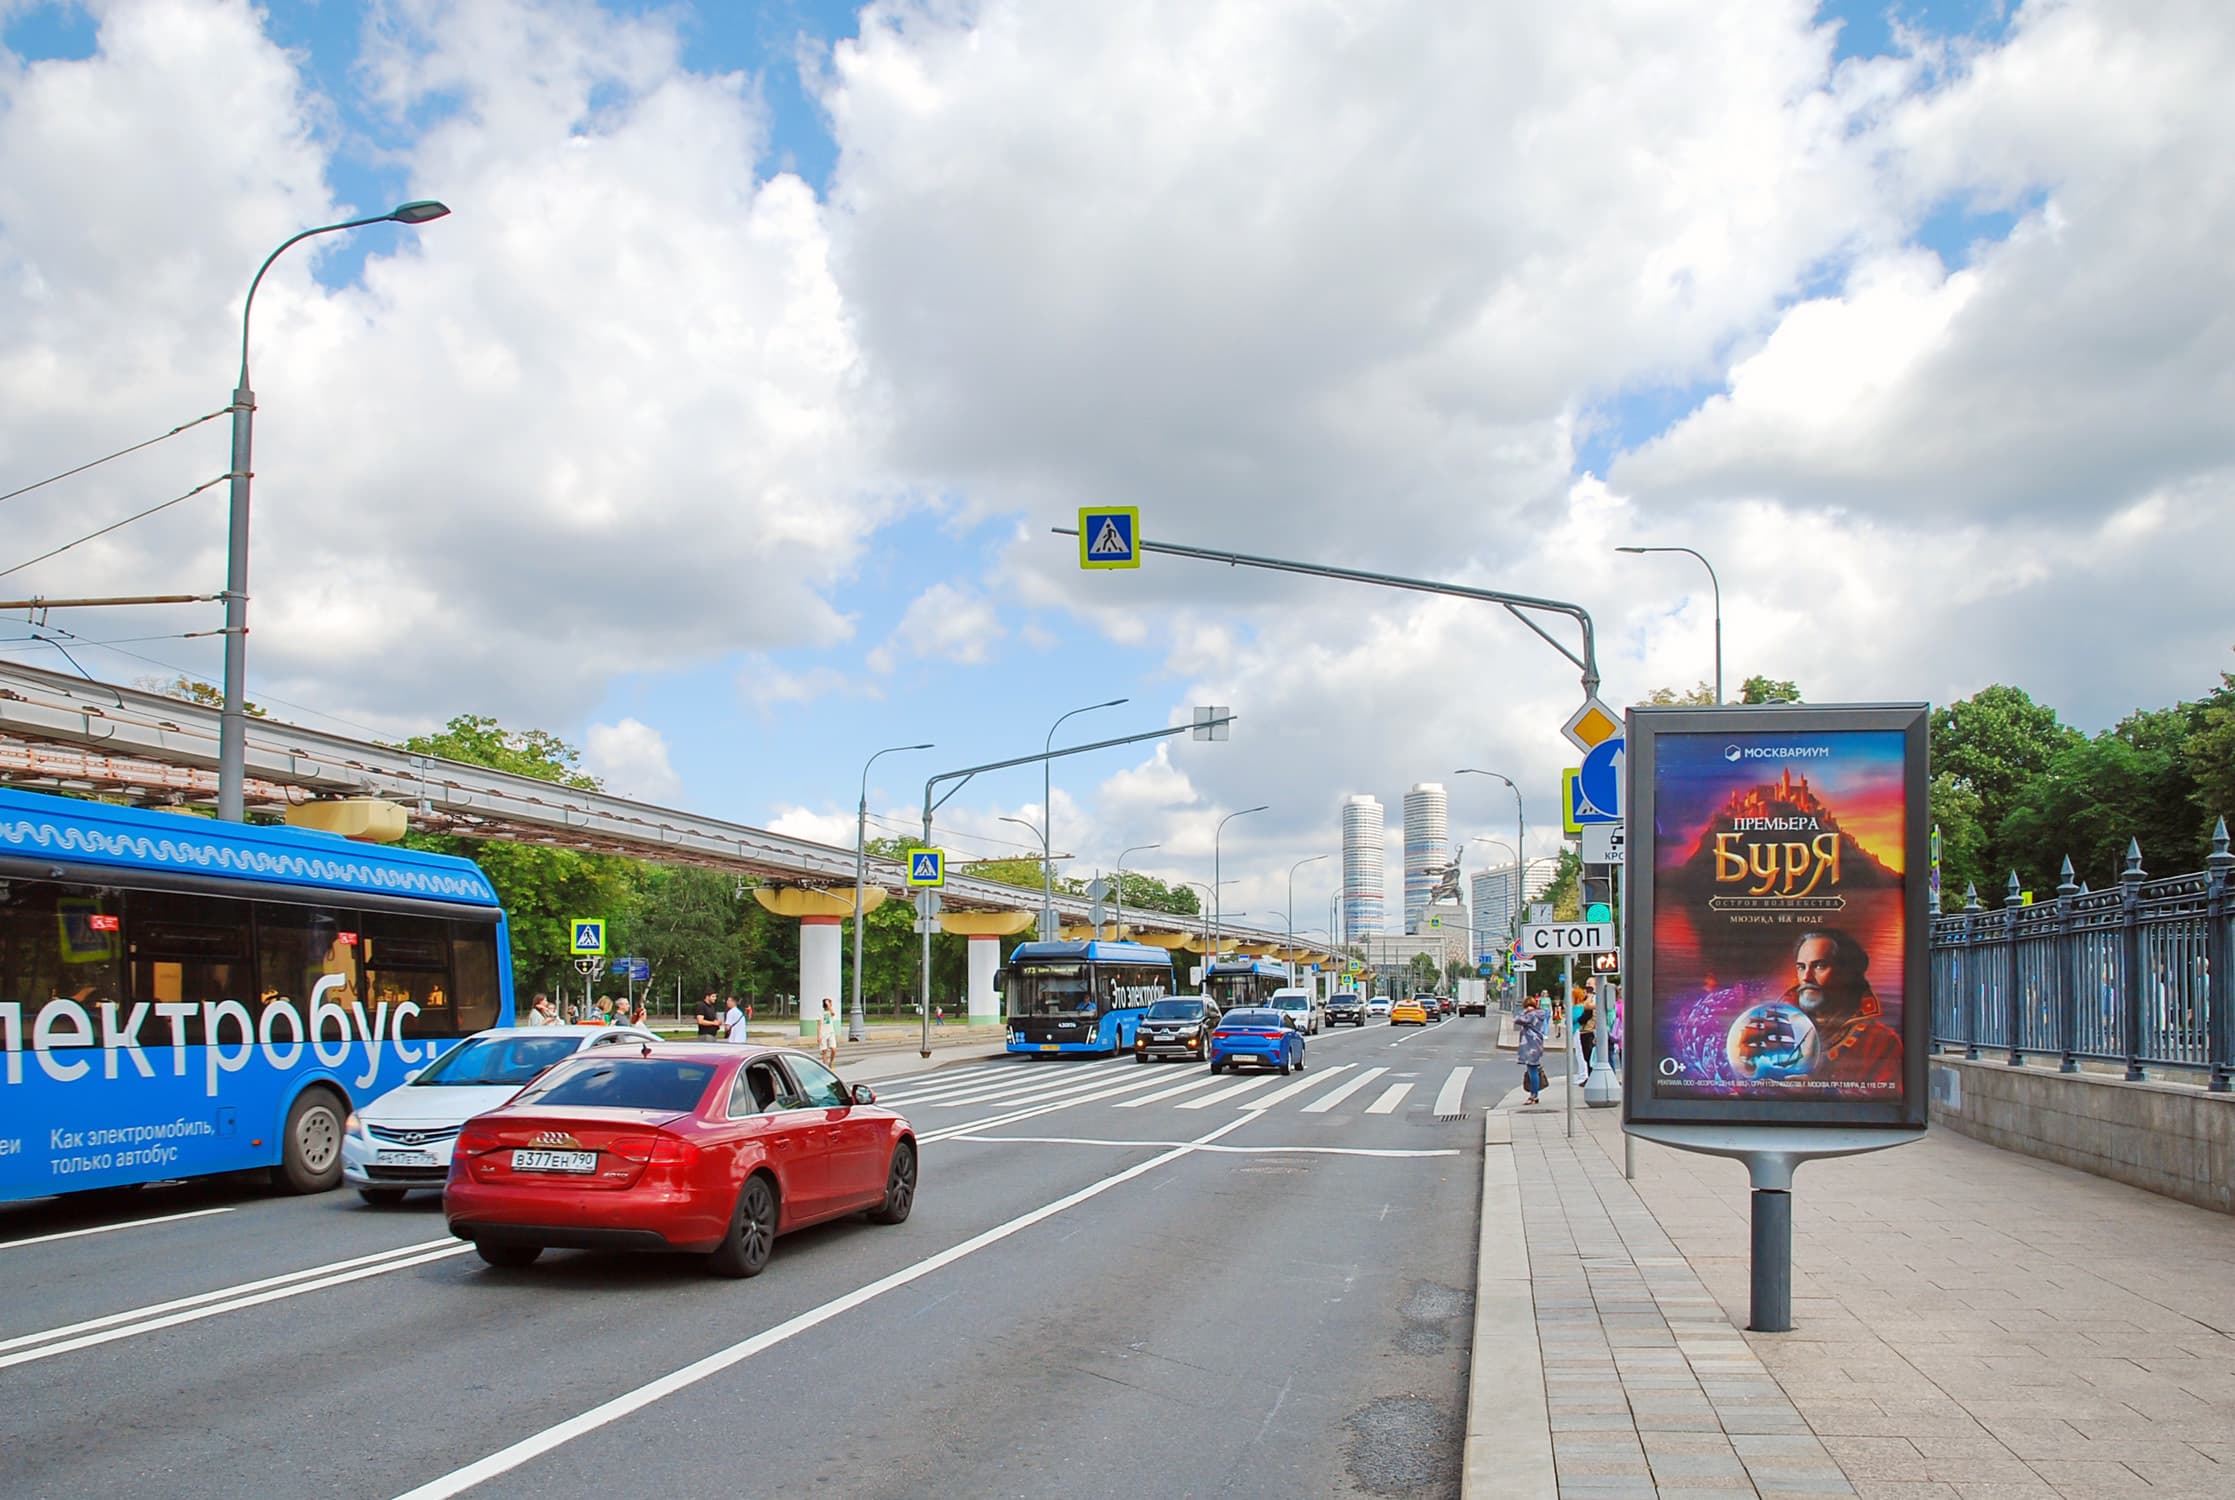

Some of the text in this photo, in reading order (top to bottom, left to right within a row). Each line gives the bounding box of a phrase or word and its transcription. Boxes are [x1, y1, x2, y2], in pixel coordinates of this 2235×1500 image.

[1744, 747, 1829, 759] МОСКВАРИУМ
[1733, 816, 1820, 831] ПРЕМЬЕРА
[1714, 899, 1756, 907] ОСТРОВ
[1778, 915, 1792, 924] НА
[1797, 914, 1823, 924] ВОДЕ
[1534, 927, 1601, 949] СТОП
[1110, 977, 1127, 1009] Это
[1659, 1057, 1687, 1076] 0+
[51, 1117, 216, 1150] Как электромобиль,
[51, 1143, 178, 1175] только автобус
